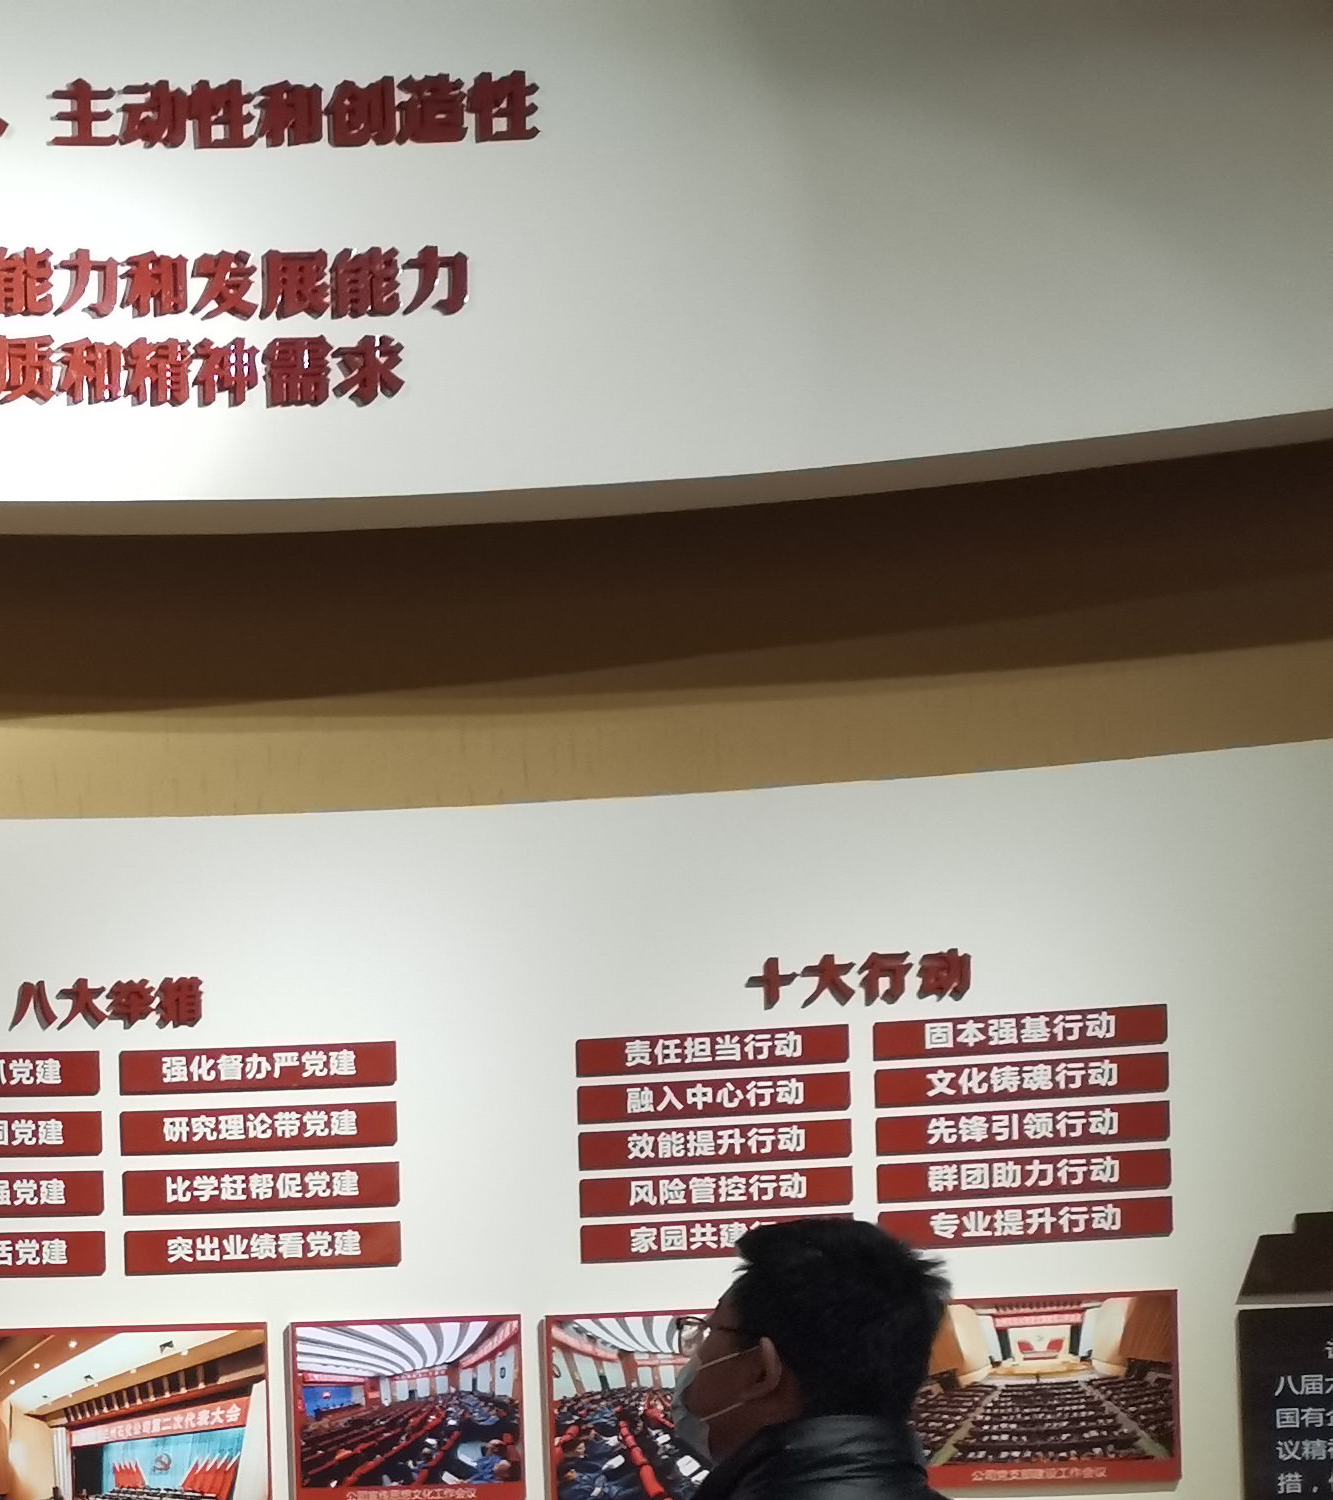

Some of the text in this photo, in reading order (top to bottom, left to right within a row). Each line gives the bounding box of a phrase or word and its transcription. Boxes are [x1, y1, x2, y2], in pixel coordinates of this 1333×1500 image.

[745, 948, 973, 1010] 十大行动
[8, 976, 205, 1031] 八大举措
[924, 1011, 1117, 1049] 固本强基行动
[161, 1048, 358, 1084] 强化督办严党建
[624, 1032, 803, 1067] 责任担当行动
[626, 1078, 805, 1114] 融入中心行动
[926, 1059, 1119, 1097] 文化铸魂行动
[163, 1108, 359, 1143] 研究理论带党建
[627, 1125, 807, 1161] 效能提升行动
[927, 1107, 1120, 1145] 先锋引领行动
[165, 1168, 361, 1203] 比学赶帮促党建
[629, 1172, 808, 1208] 风险管控行动
[928, 1156, 1121, 1194] 群团助力行动
[630, 1221, 777, 1254] 家园共建
[930, 1203, 1123, 1239] 专业提升行动
[167, 1228, 363, 1264] 突出业绩看党建
[1278, 1472, 1333, 1494] 措，
